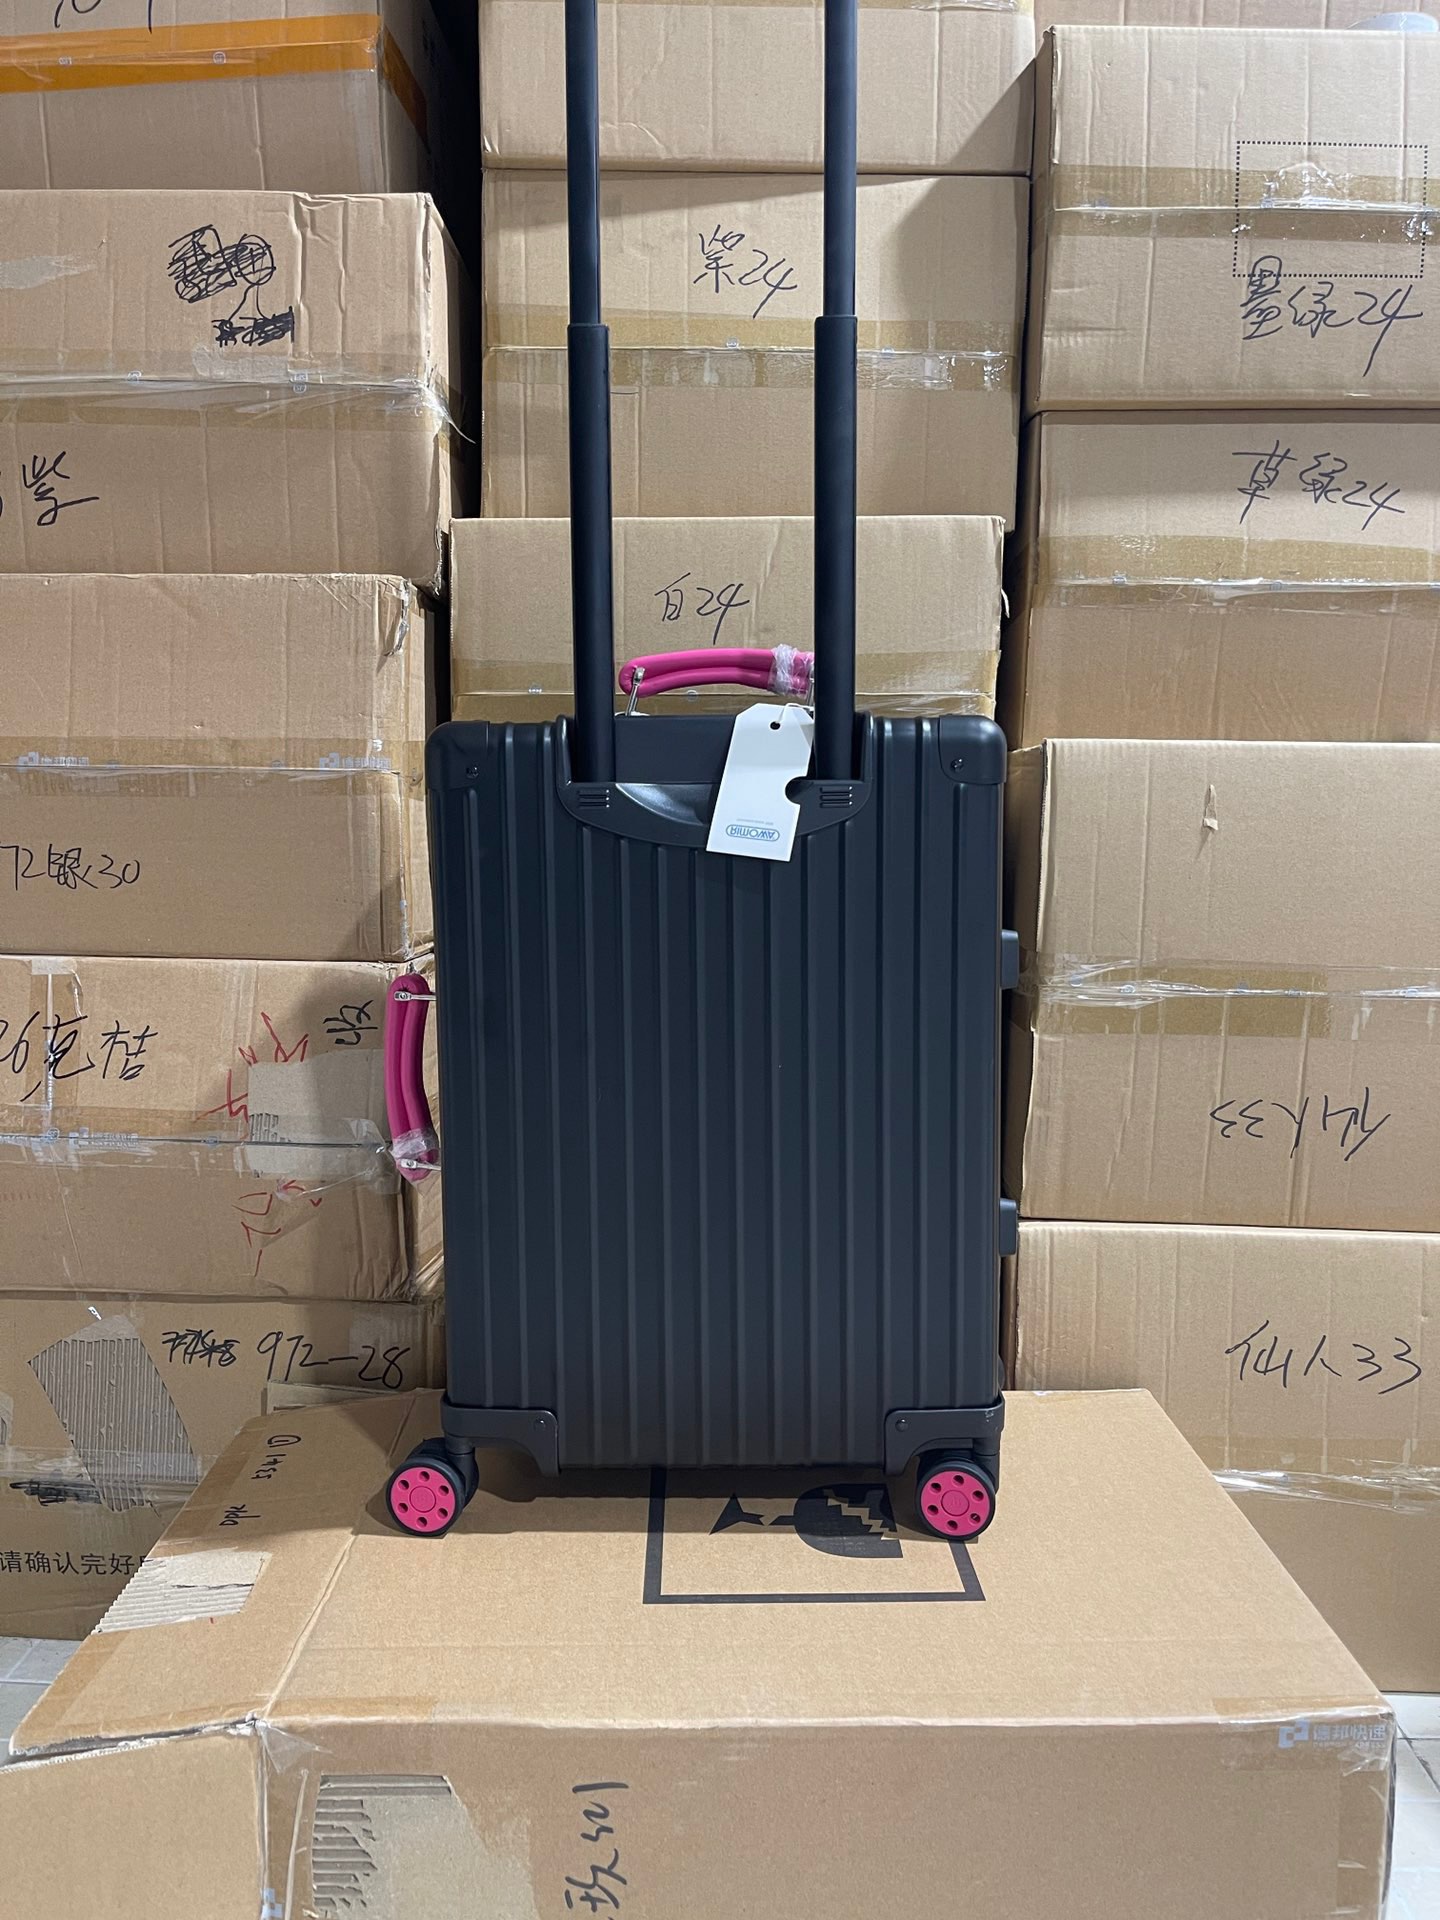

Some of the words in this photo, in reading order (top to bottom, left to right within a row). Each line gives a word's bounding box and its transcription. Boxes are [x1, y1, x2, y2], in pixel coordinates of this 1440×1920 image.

[0, 1550, 151, 1575] 请确认完好
